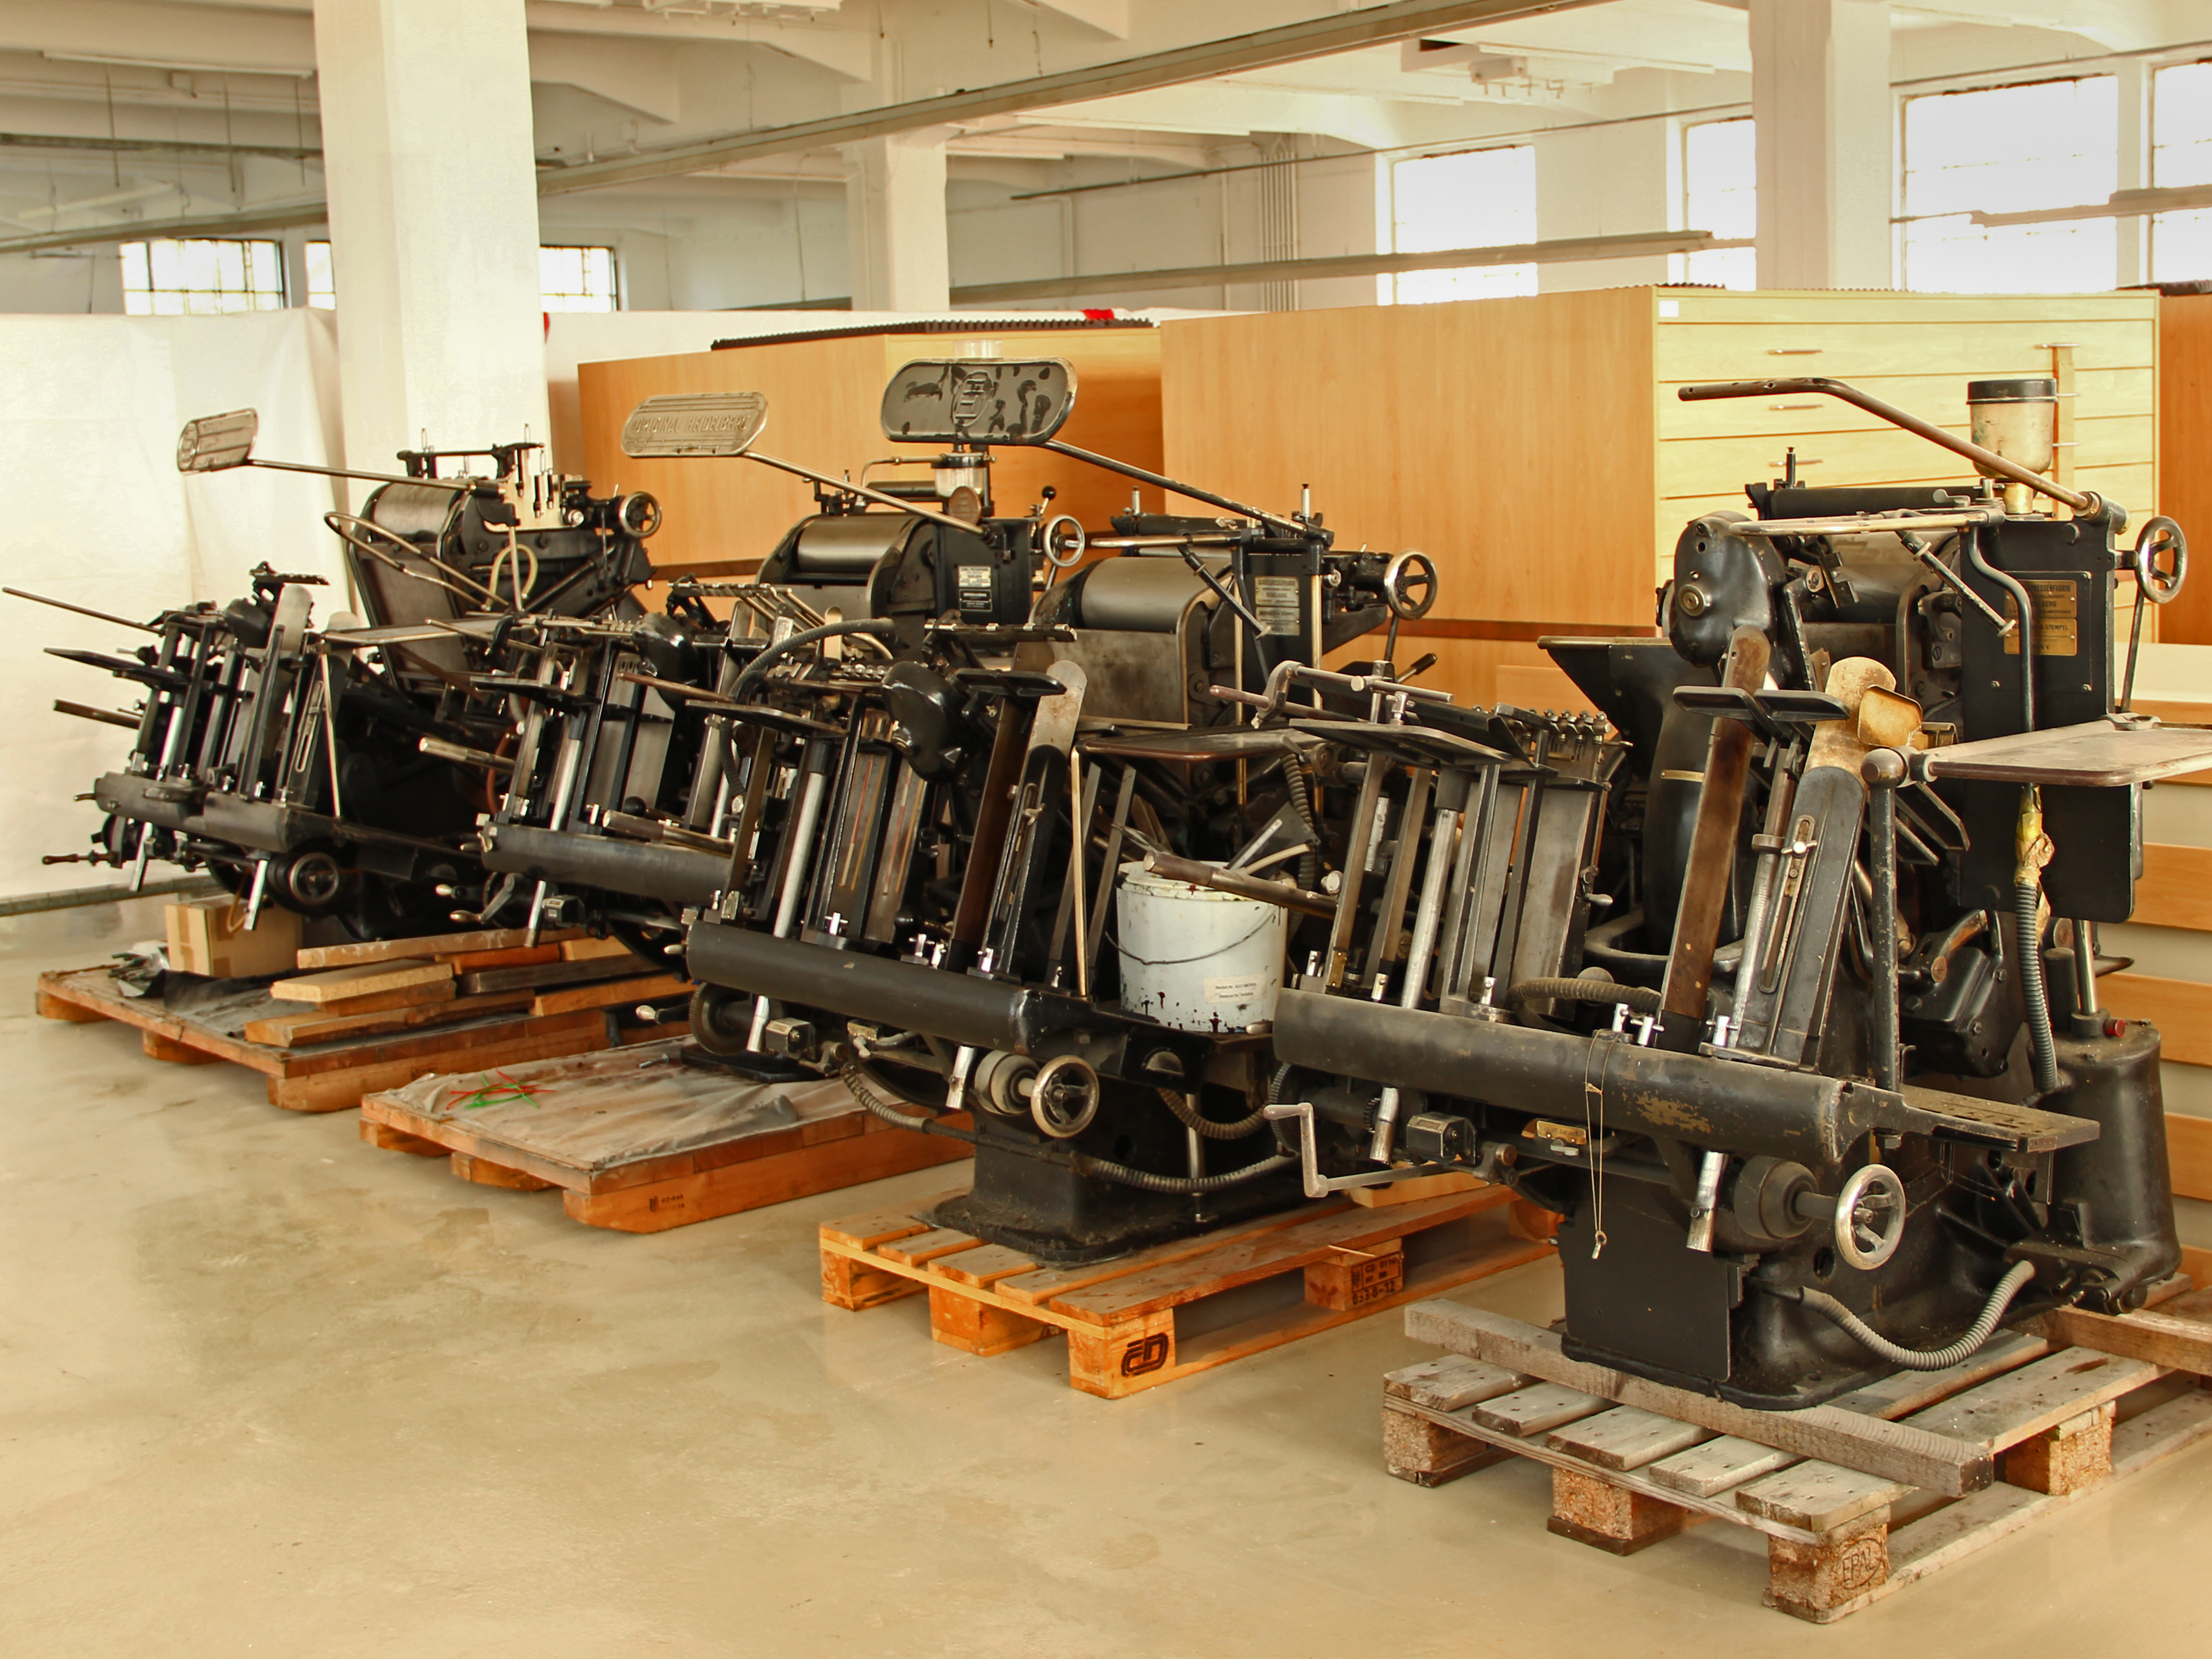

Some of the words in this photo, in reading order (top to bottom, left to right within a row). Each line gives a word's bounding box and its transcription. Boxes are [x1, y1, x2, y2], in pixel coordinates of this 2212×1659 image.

[635, 416, 679, 433] ORIGINAL
[685, 415, 751, 432] HEIDELBERG
[1841, 1546, 1877, 1584] EPAL
